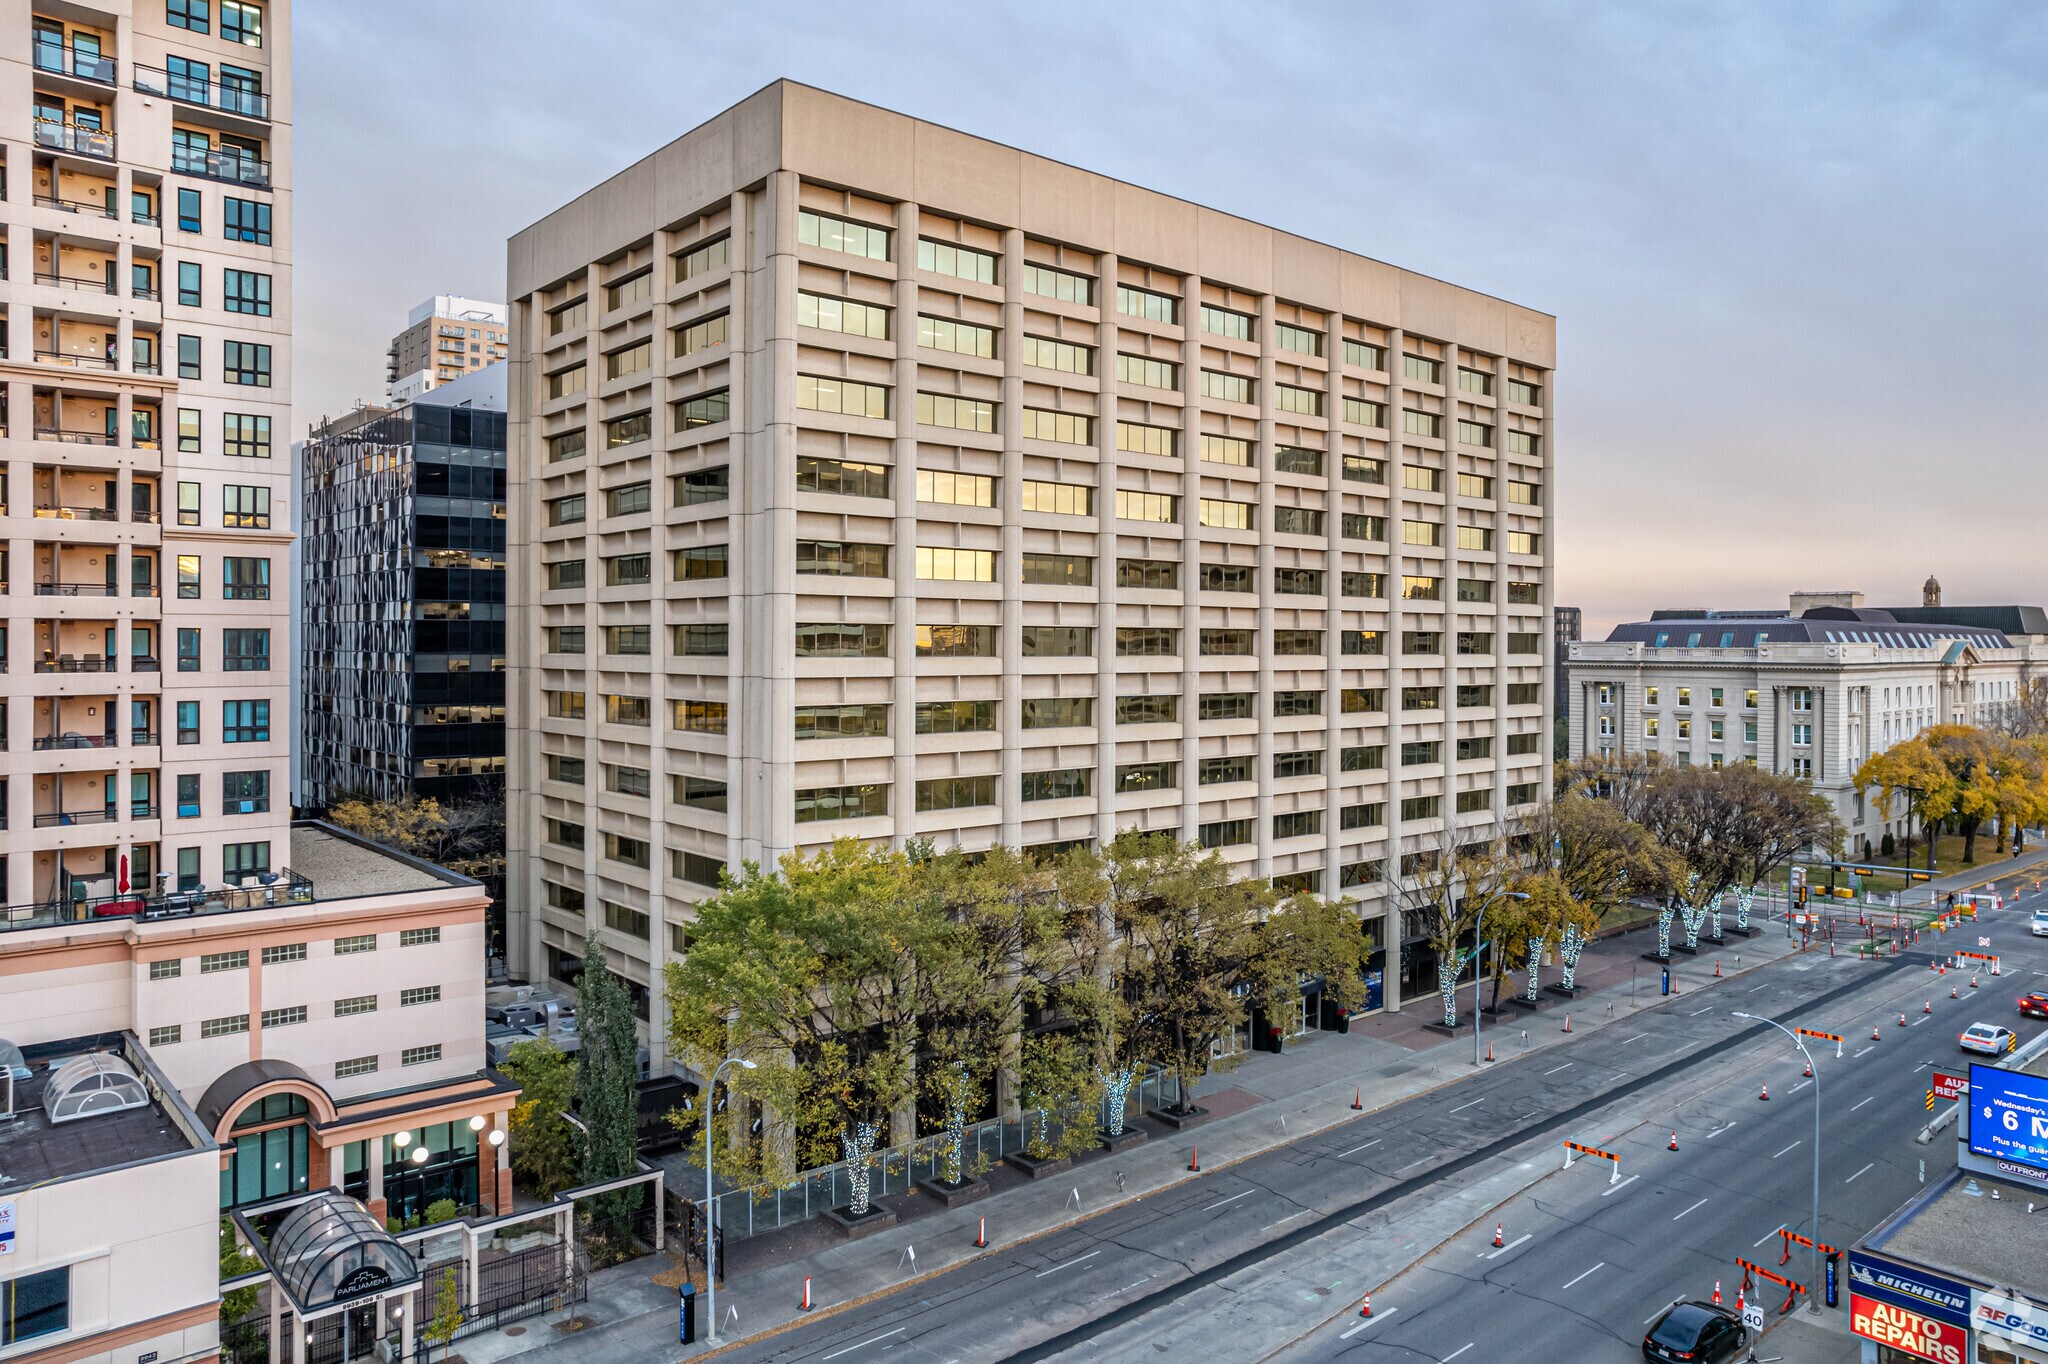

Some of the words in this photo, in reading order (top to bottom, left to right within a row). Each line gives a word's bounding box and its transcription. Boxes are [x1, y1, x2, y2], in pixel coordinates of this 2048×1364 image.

[1983, 1106, 1993, 1119] $
[2002, 1110, 2019, 1131] 6
[1993, 1098, 2046, 1116] Wednesday's
[1992, 1135, 2011, 1146] Plus
[2012, 1140, 2027, 1150] the
[1999, 1162, 2047, 1179] OUTFRONT
[337, 1275, 390, 1296] PARLIAMENT
[1877, 1274, 1965, 1308] MICHELIN
[1744, 1313, 1762, 1327] 40
[1872, 1303, 1942, 1340] AUTO
[1977, 1304, 2048, 1338] BFGoo
[1854, 1313, 1960, 1364] REPAIRS
